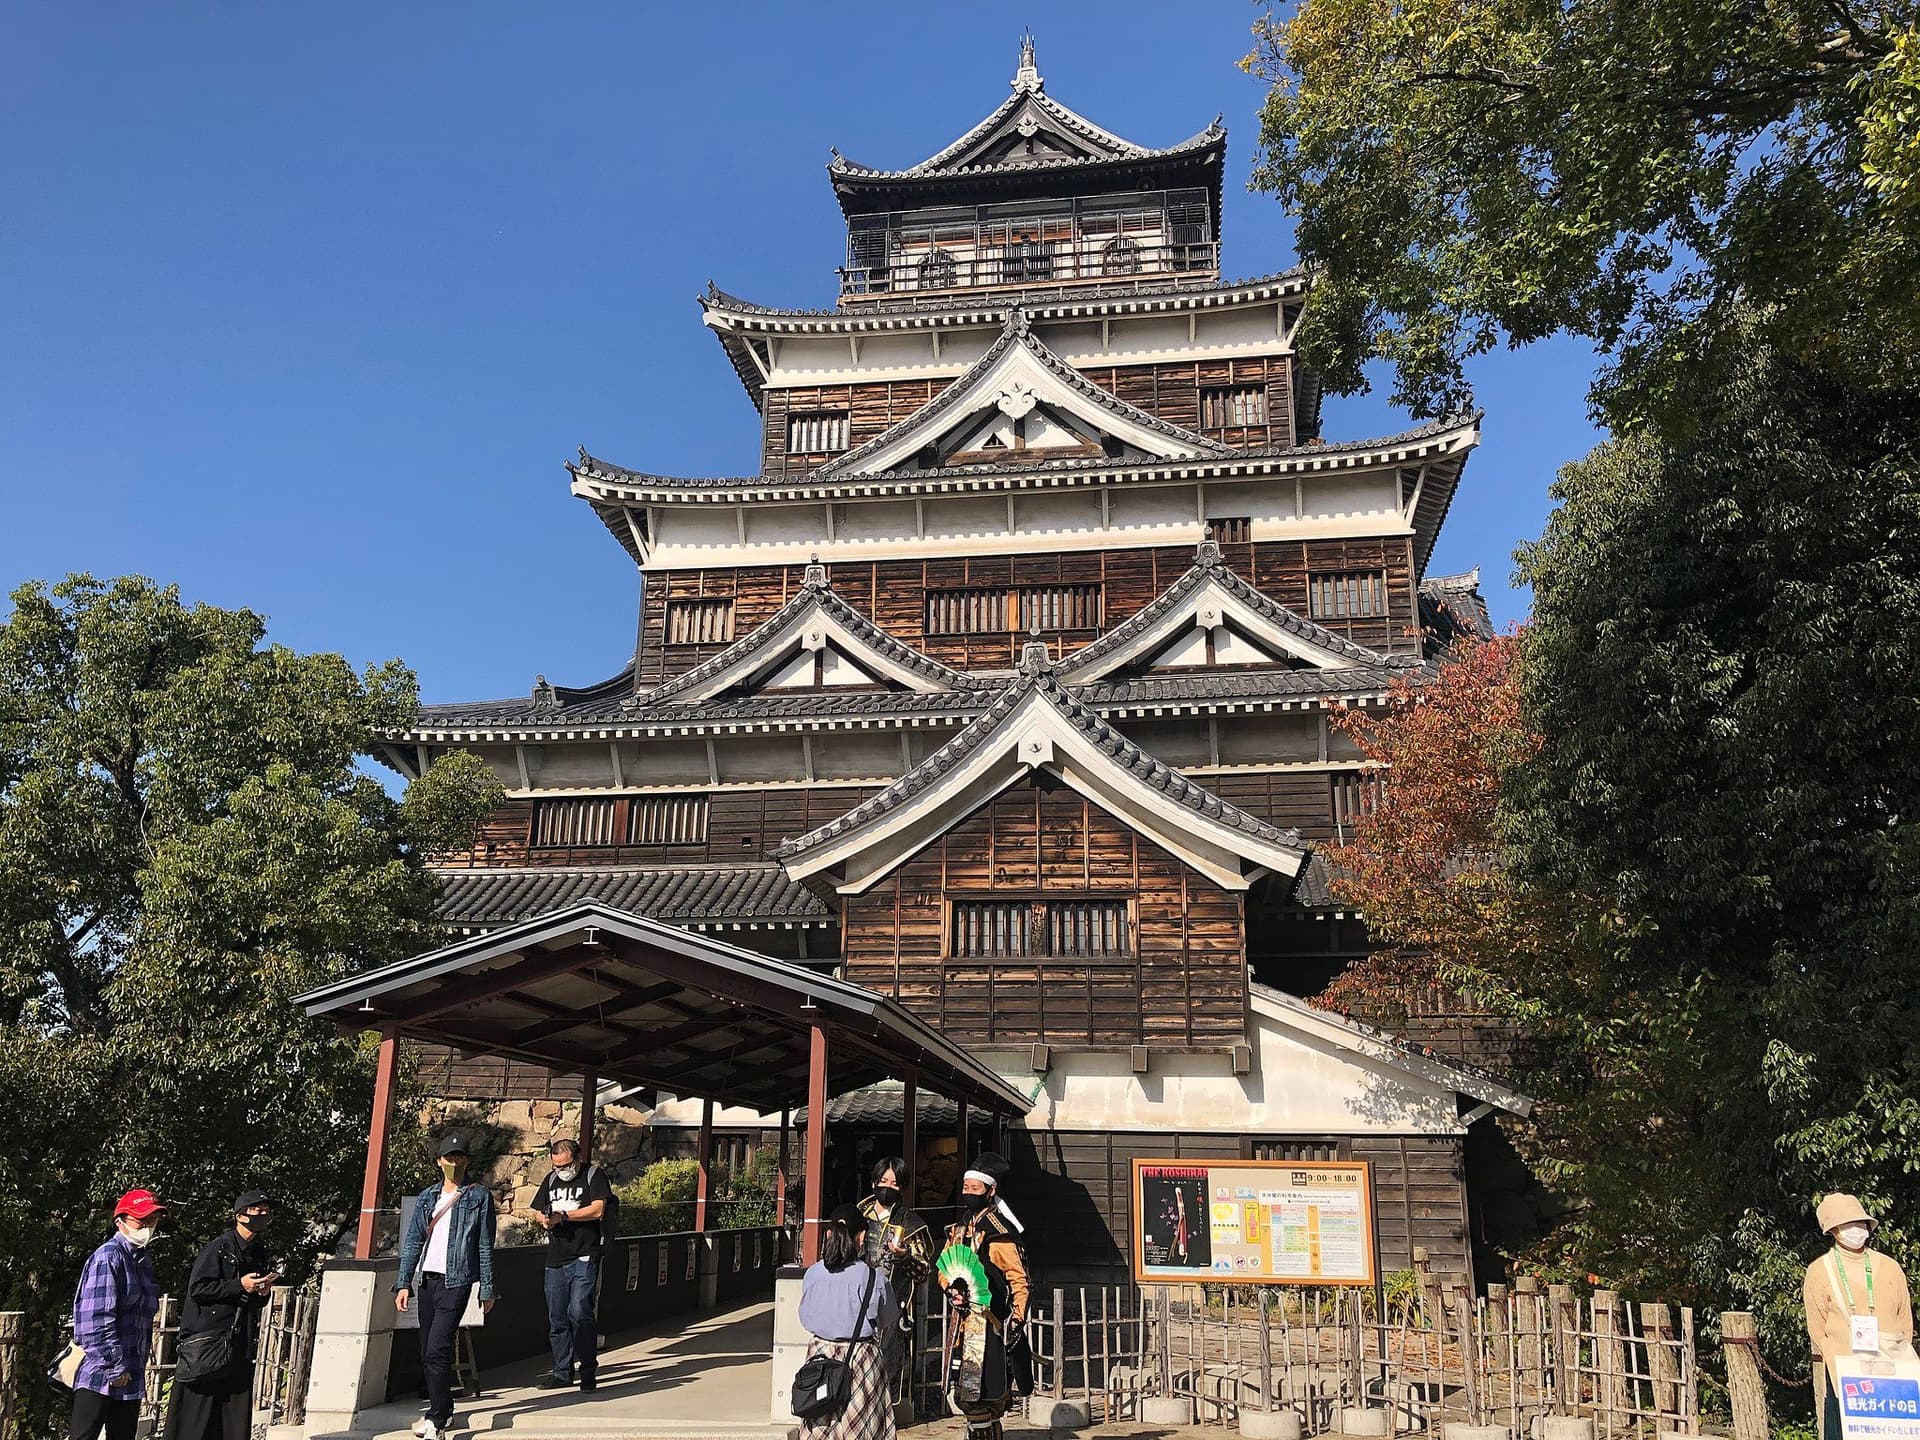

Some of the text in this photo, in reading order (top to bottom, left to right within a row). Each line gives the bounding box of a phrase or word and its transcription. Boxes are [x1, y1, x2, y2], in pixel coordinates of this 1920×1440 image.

[1847, 1397, 1917, 1414] 観光ガイドの日
